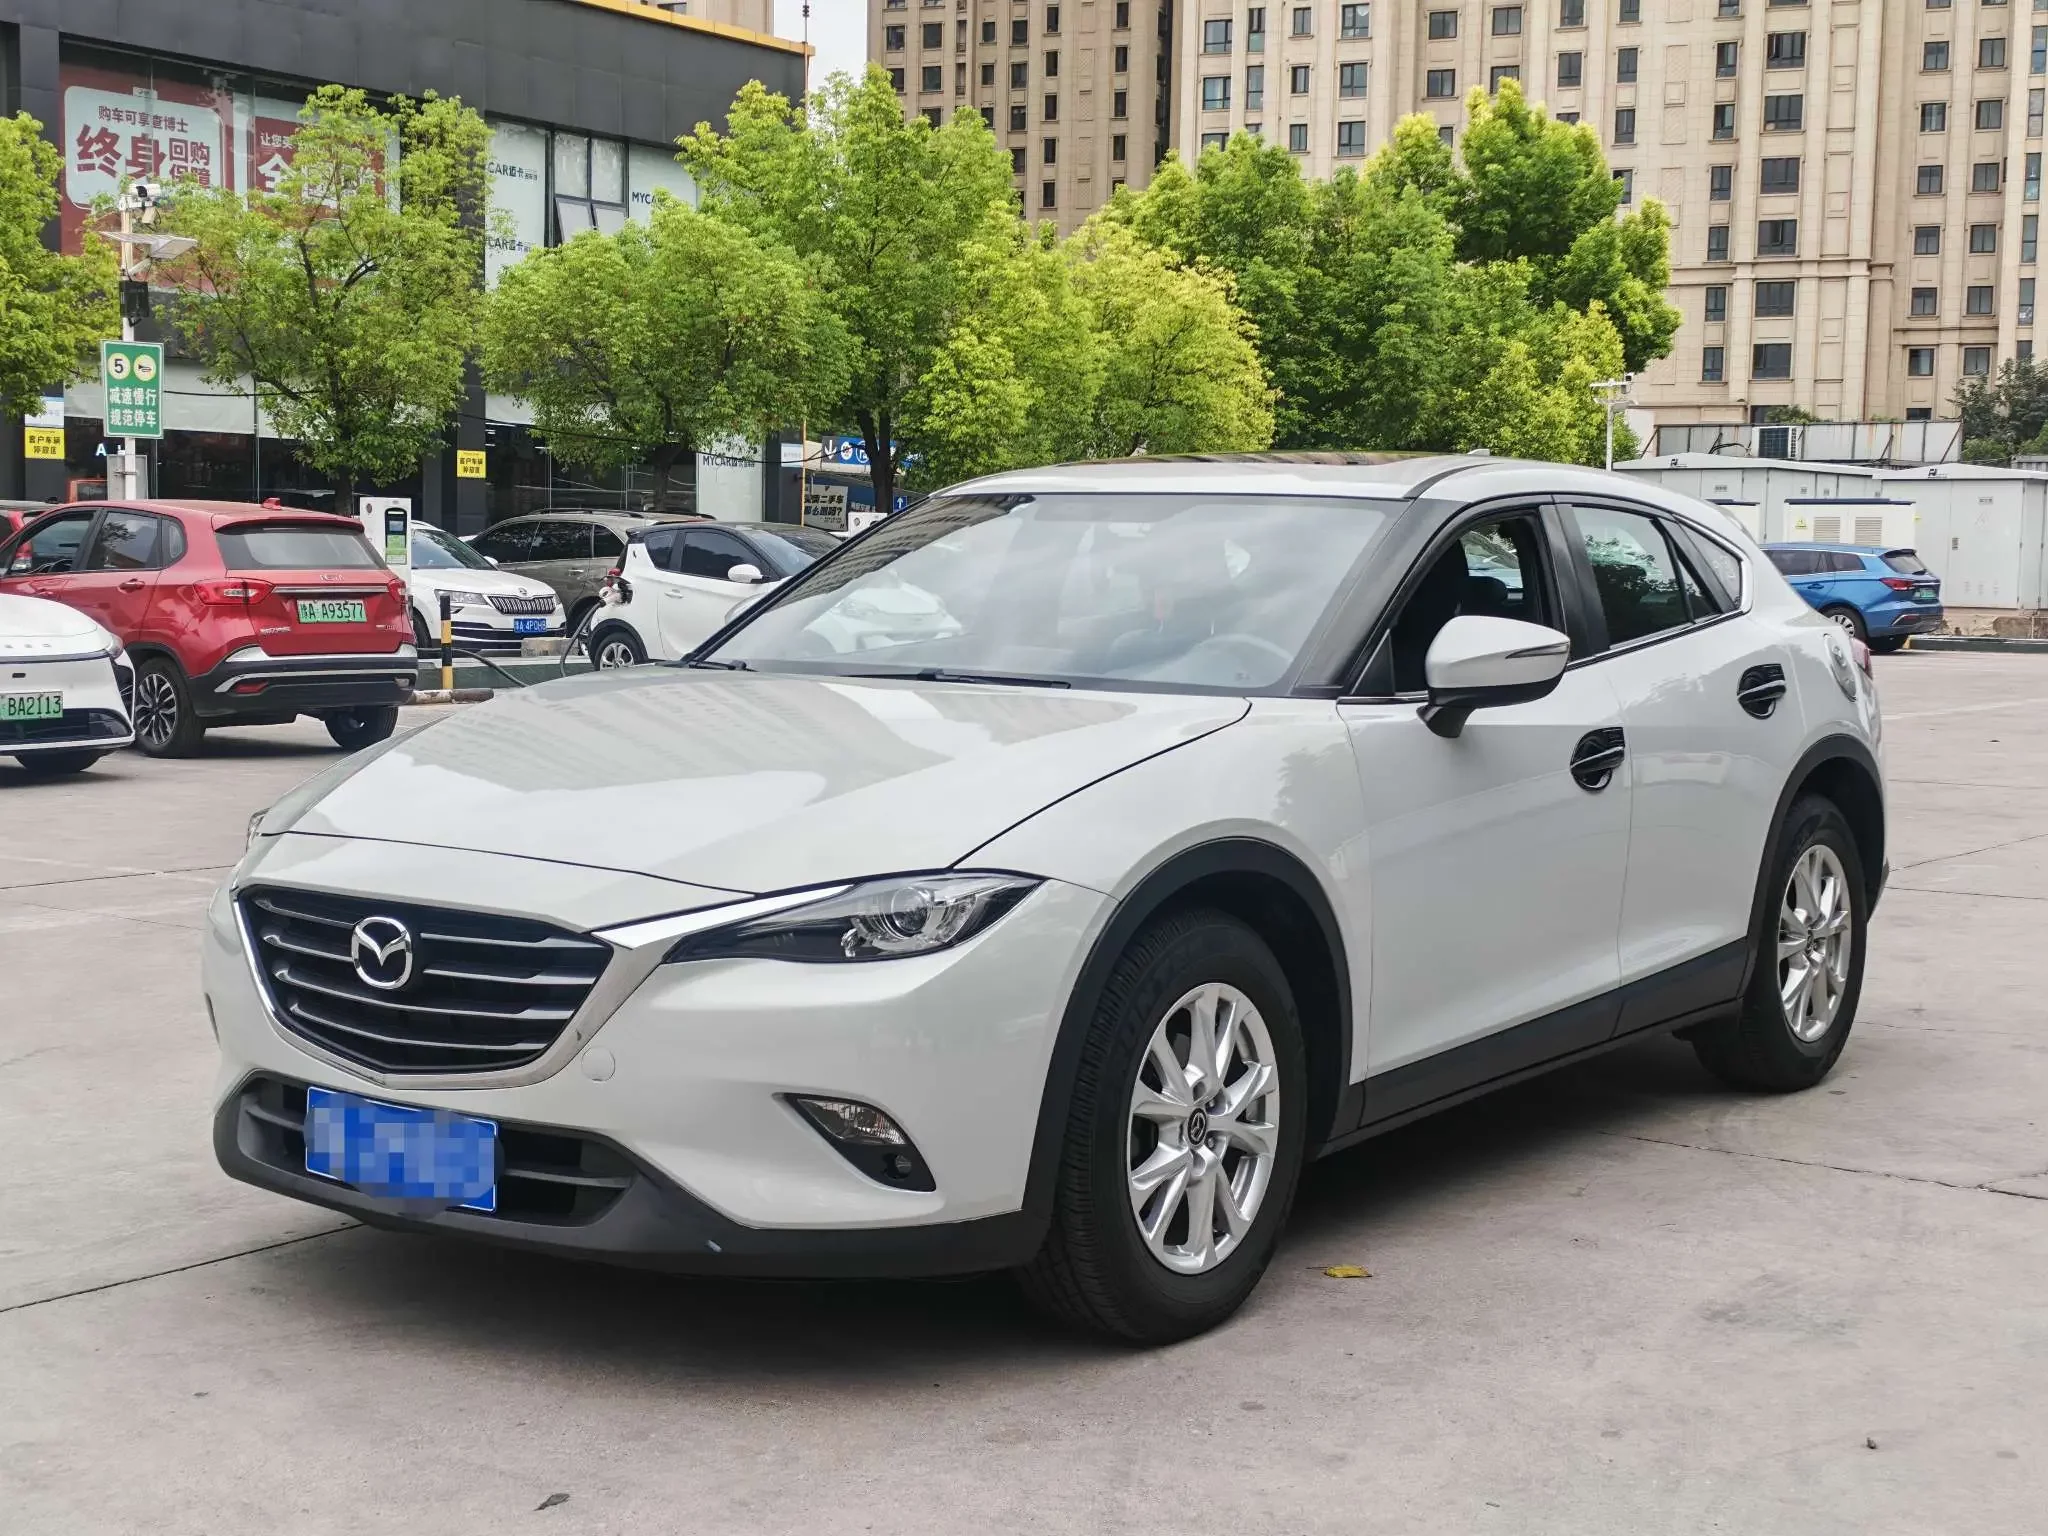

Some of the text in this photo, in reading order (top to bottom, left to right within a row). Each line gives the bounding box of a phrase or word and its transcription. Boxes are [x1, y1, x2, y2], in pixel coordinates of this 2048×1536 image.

[76, 123, 167, 180] 终身
[169, 137, 210, 166] 回购
[114, 358, 124, 373] 5
[109, 386, 157, 406] 减速慢行
[110, 408, 157, 428] 规范停车
[8, 696, 61, 716] BA2113
